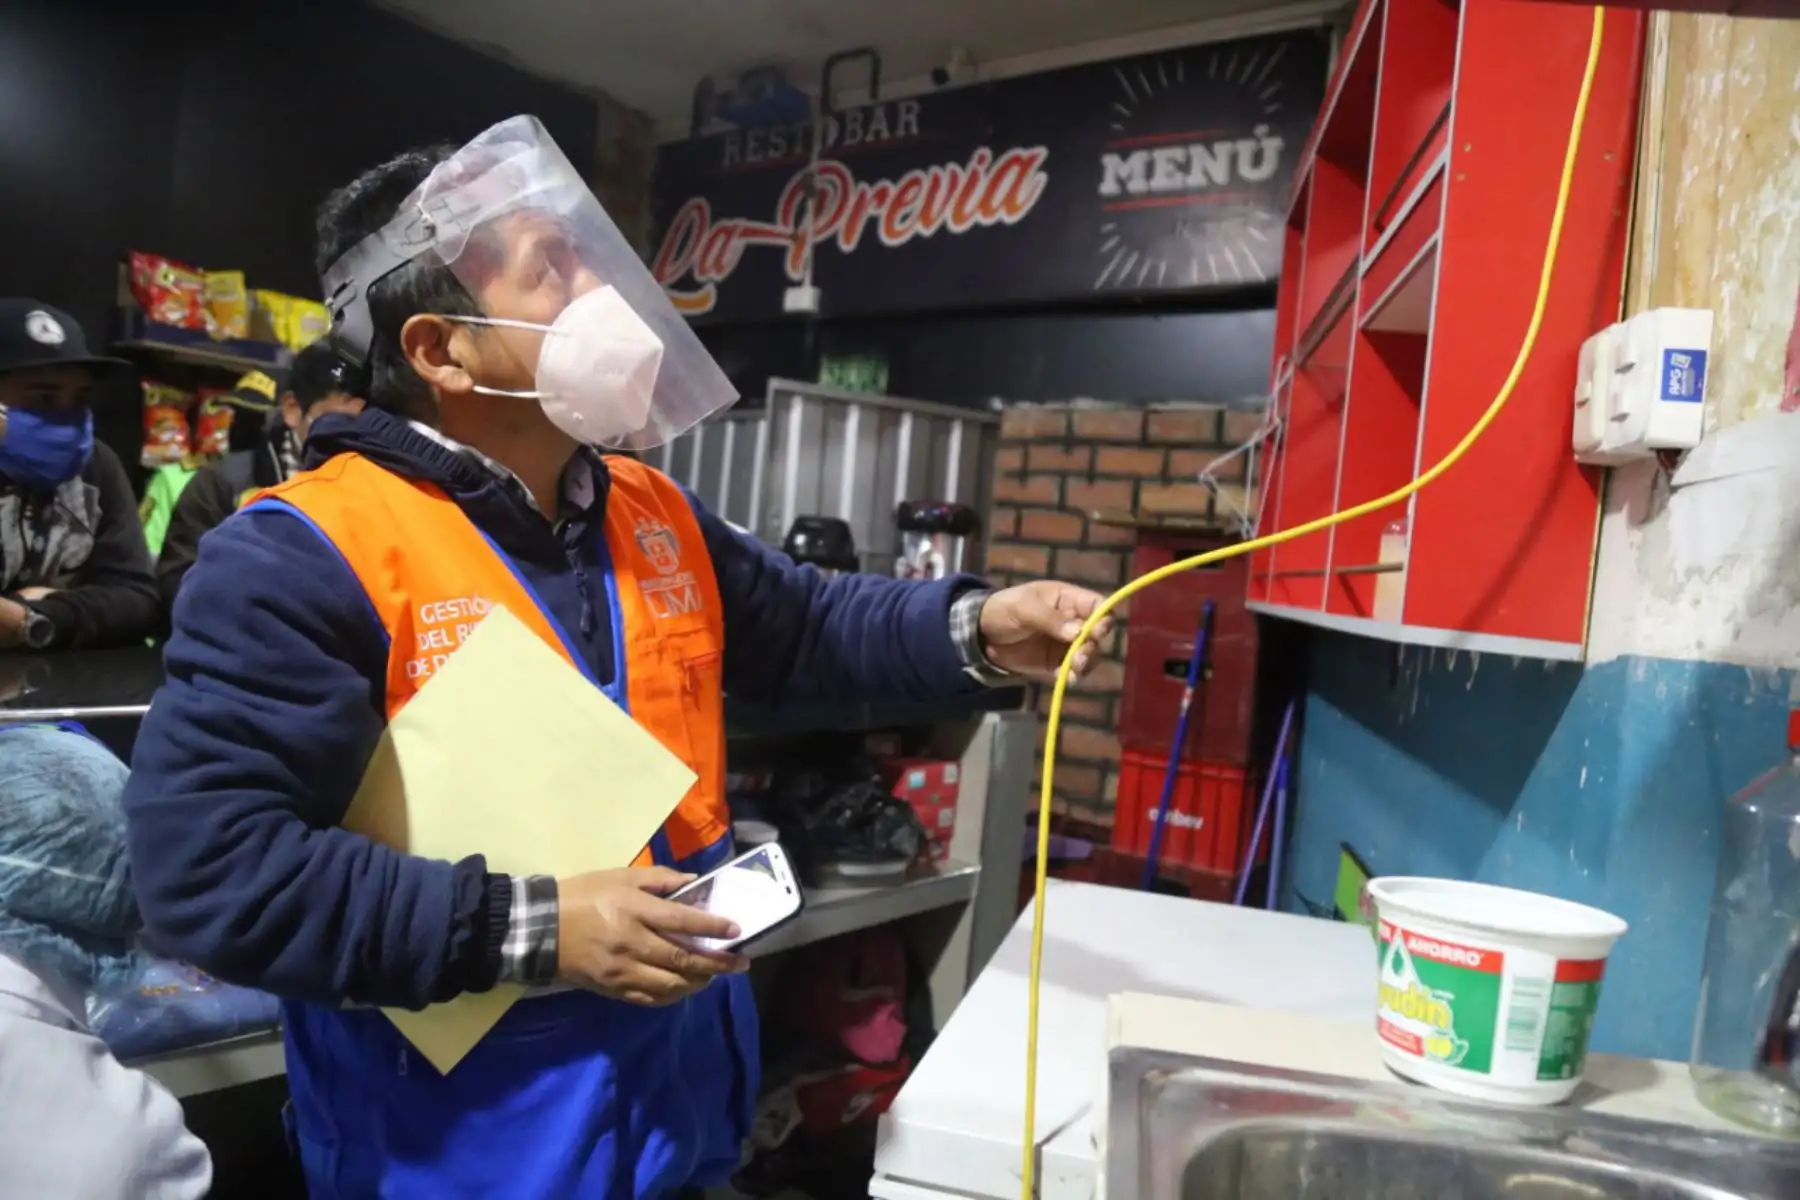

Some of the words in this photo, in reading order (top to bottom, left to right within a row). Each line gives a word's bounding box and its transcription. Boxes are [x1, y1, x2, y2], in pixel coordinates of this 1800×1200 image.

[1098, 124, 1284, 196] MENÚ
[778, 146, 1048, 281] Previa
[420, 592, 491, 624] GESTIÓ
[417, 627, 456, 652] DEL
[405, 657, 432, 680] DE
